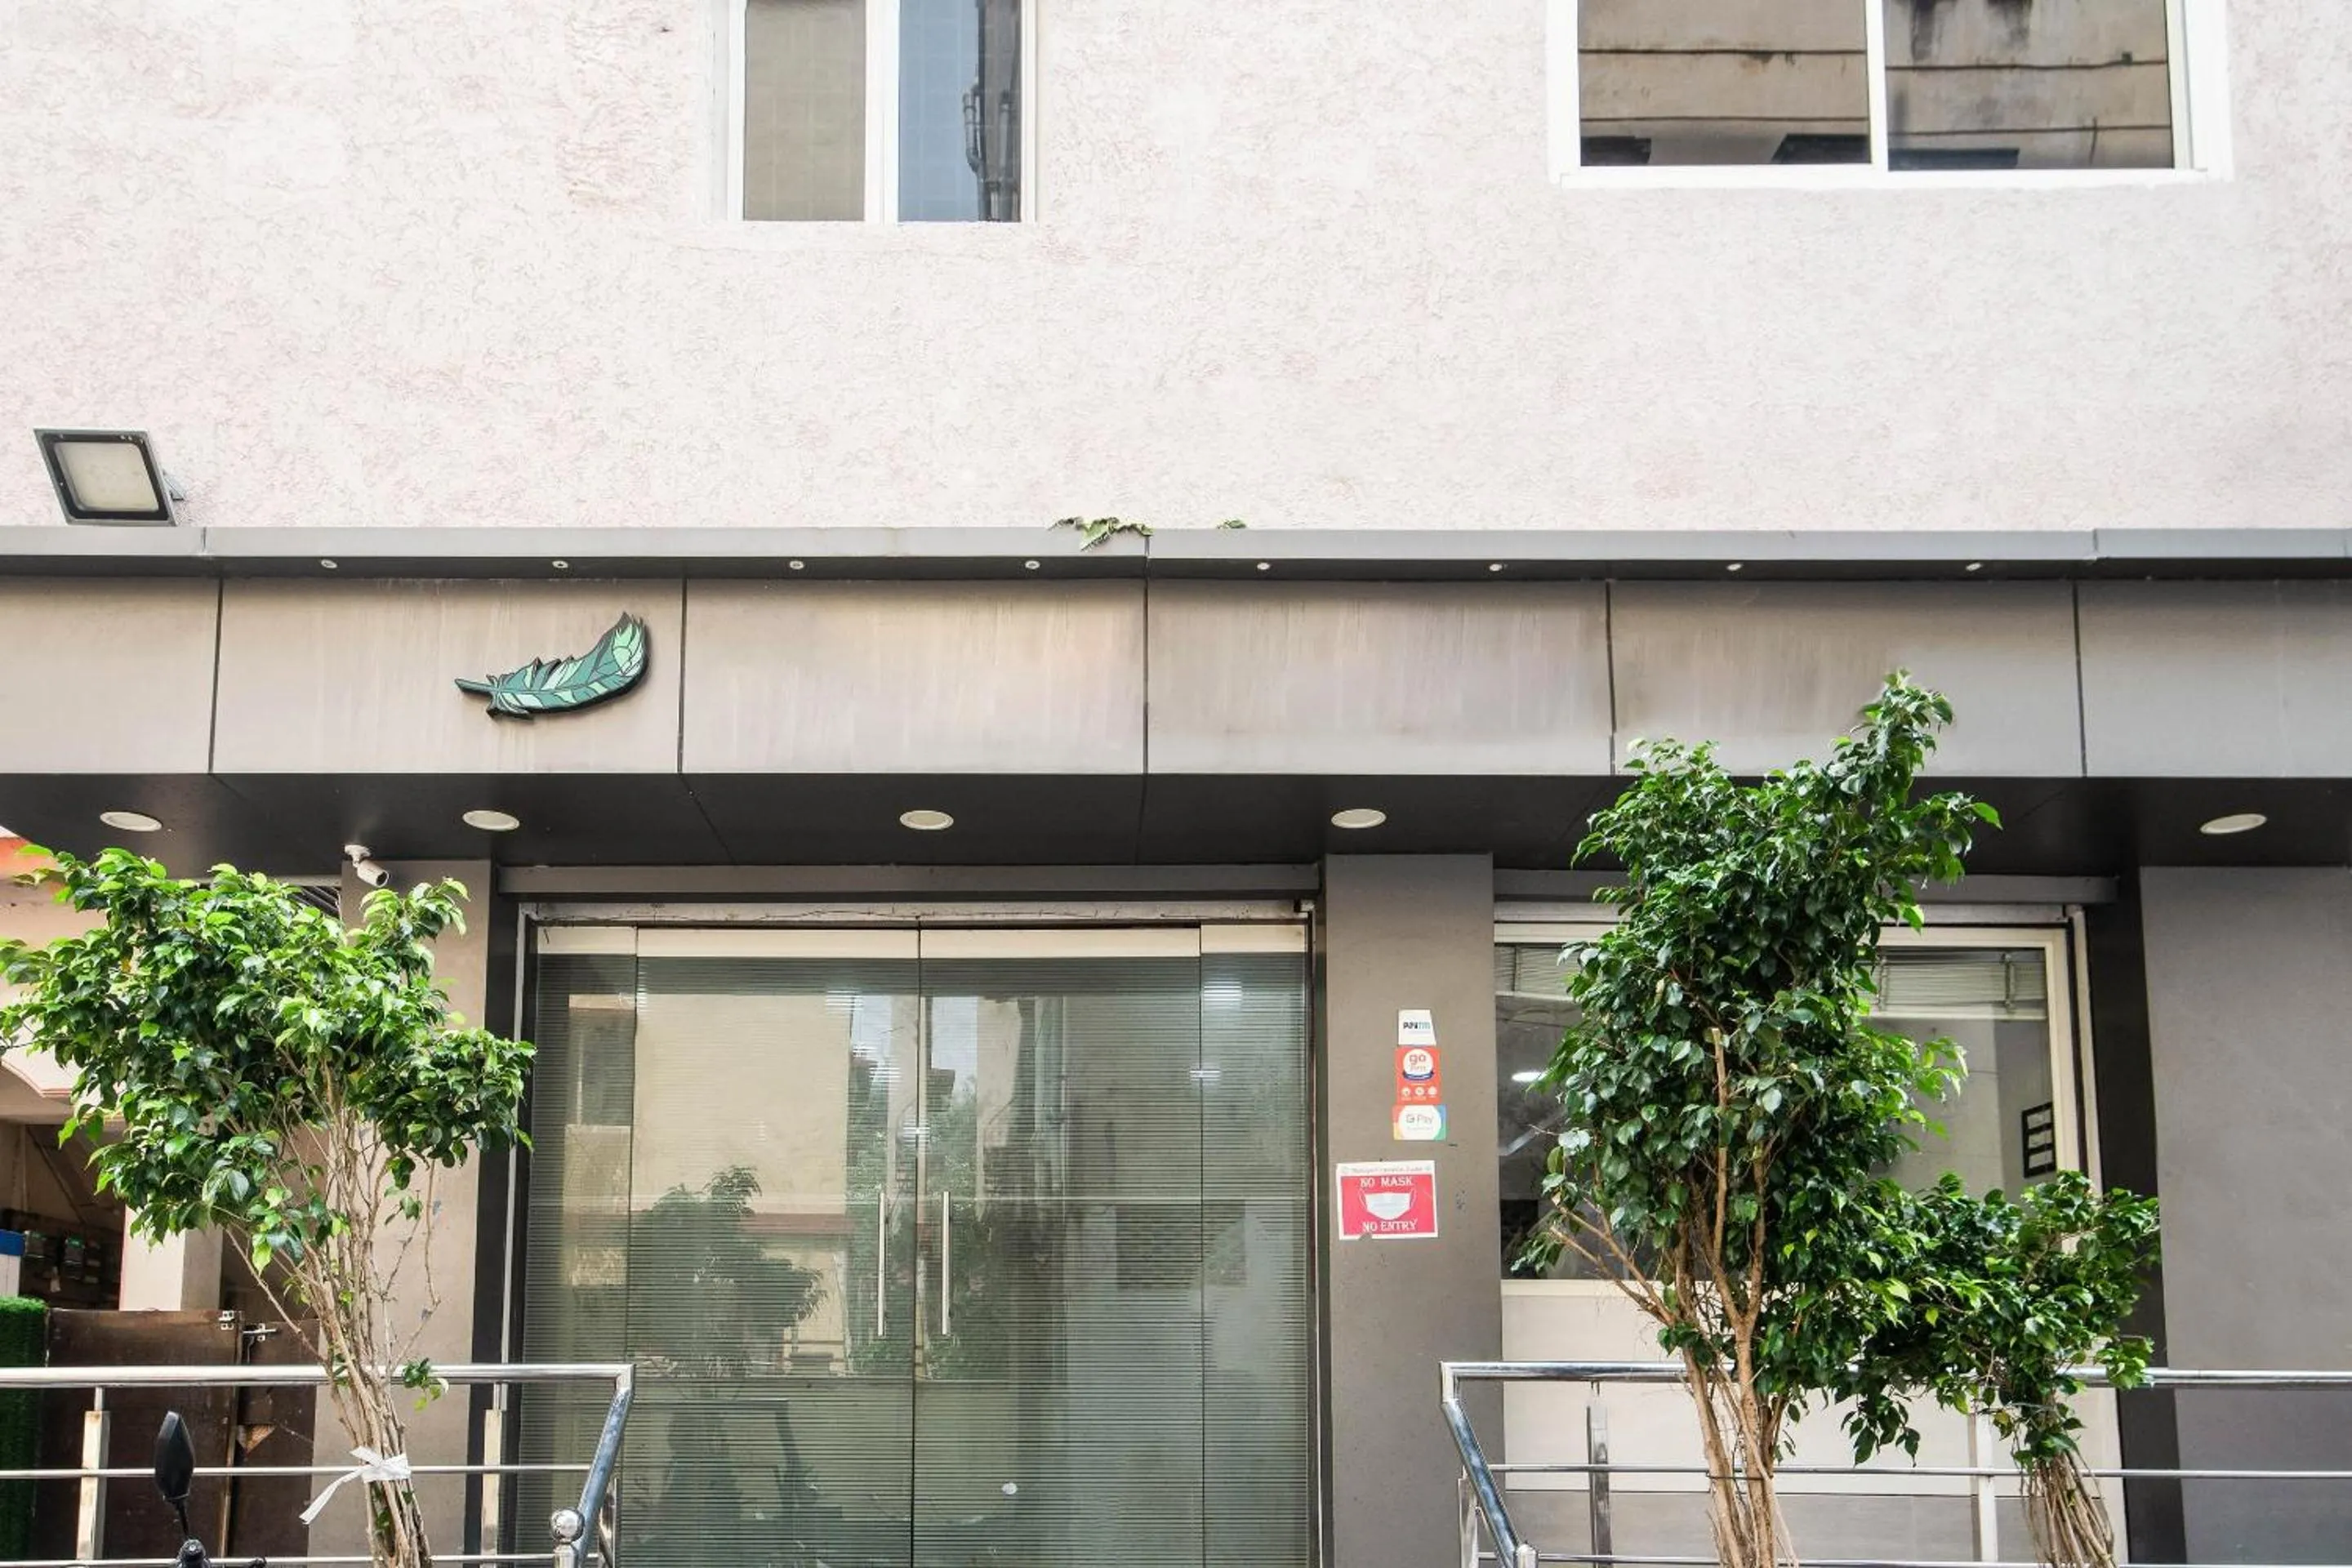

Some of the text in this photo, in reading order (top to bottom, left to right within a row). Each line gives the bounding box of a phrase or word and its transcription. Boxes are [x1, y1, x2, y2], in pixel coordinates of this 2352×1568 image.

[1360, 1176, 1414, 1188] NO MASK
[1361, 1218, 1418, 1232] NO ENTRY
